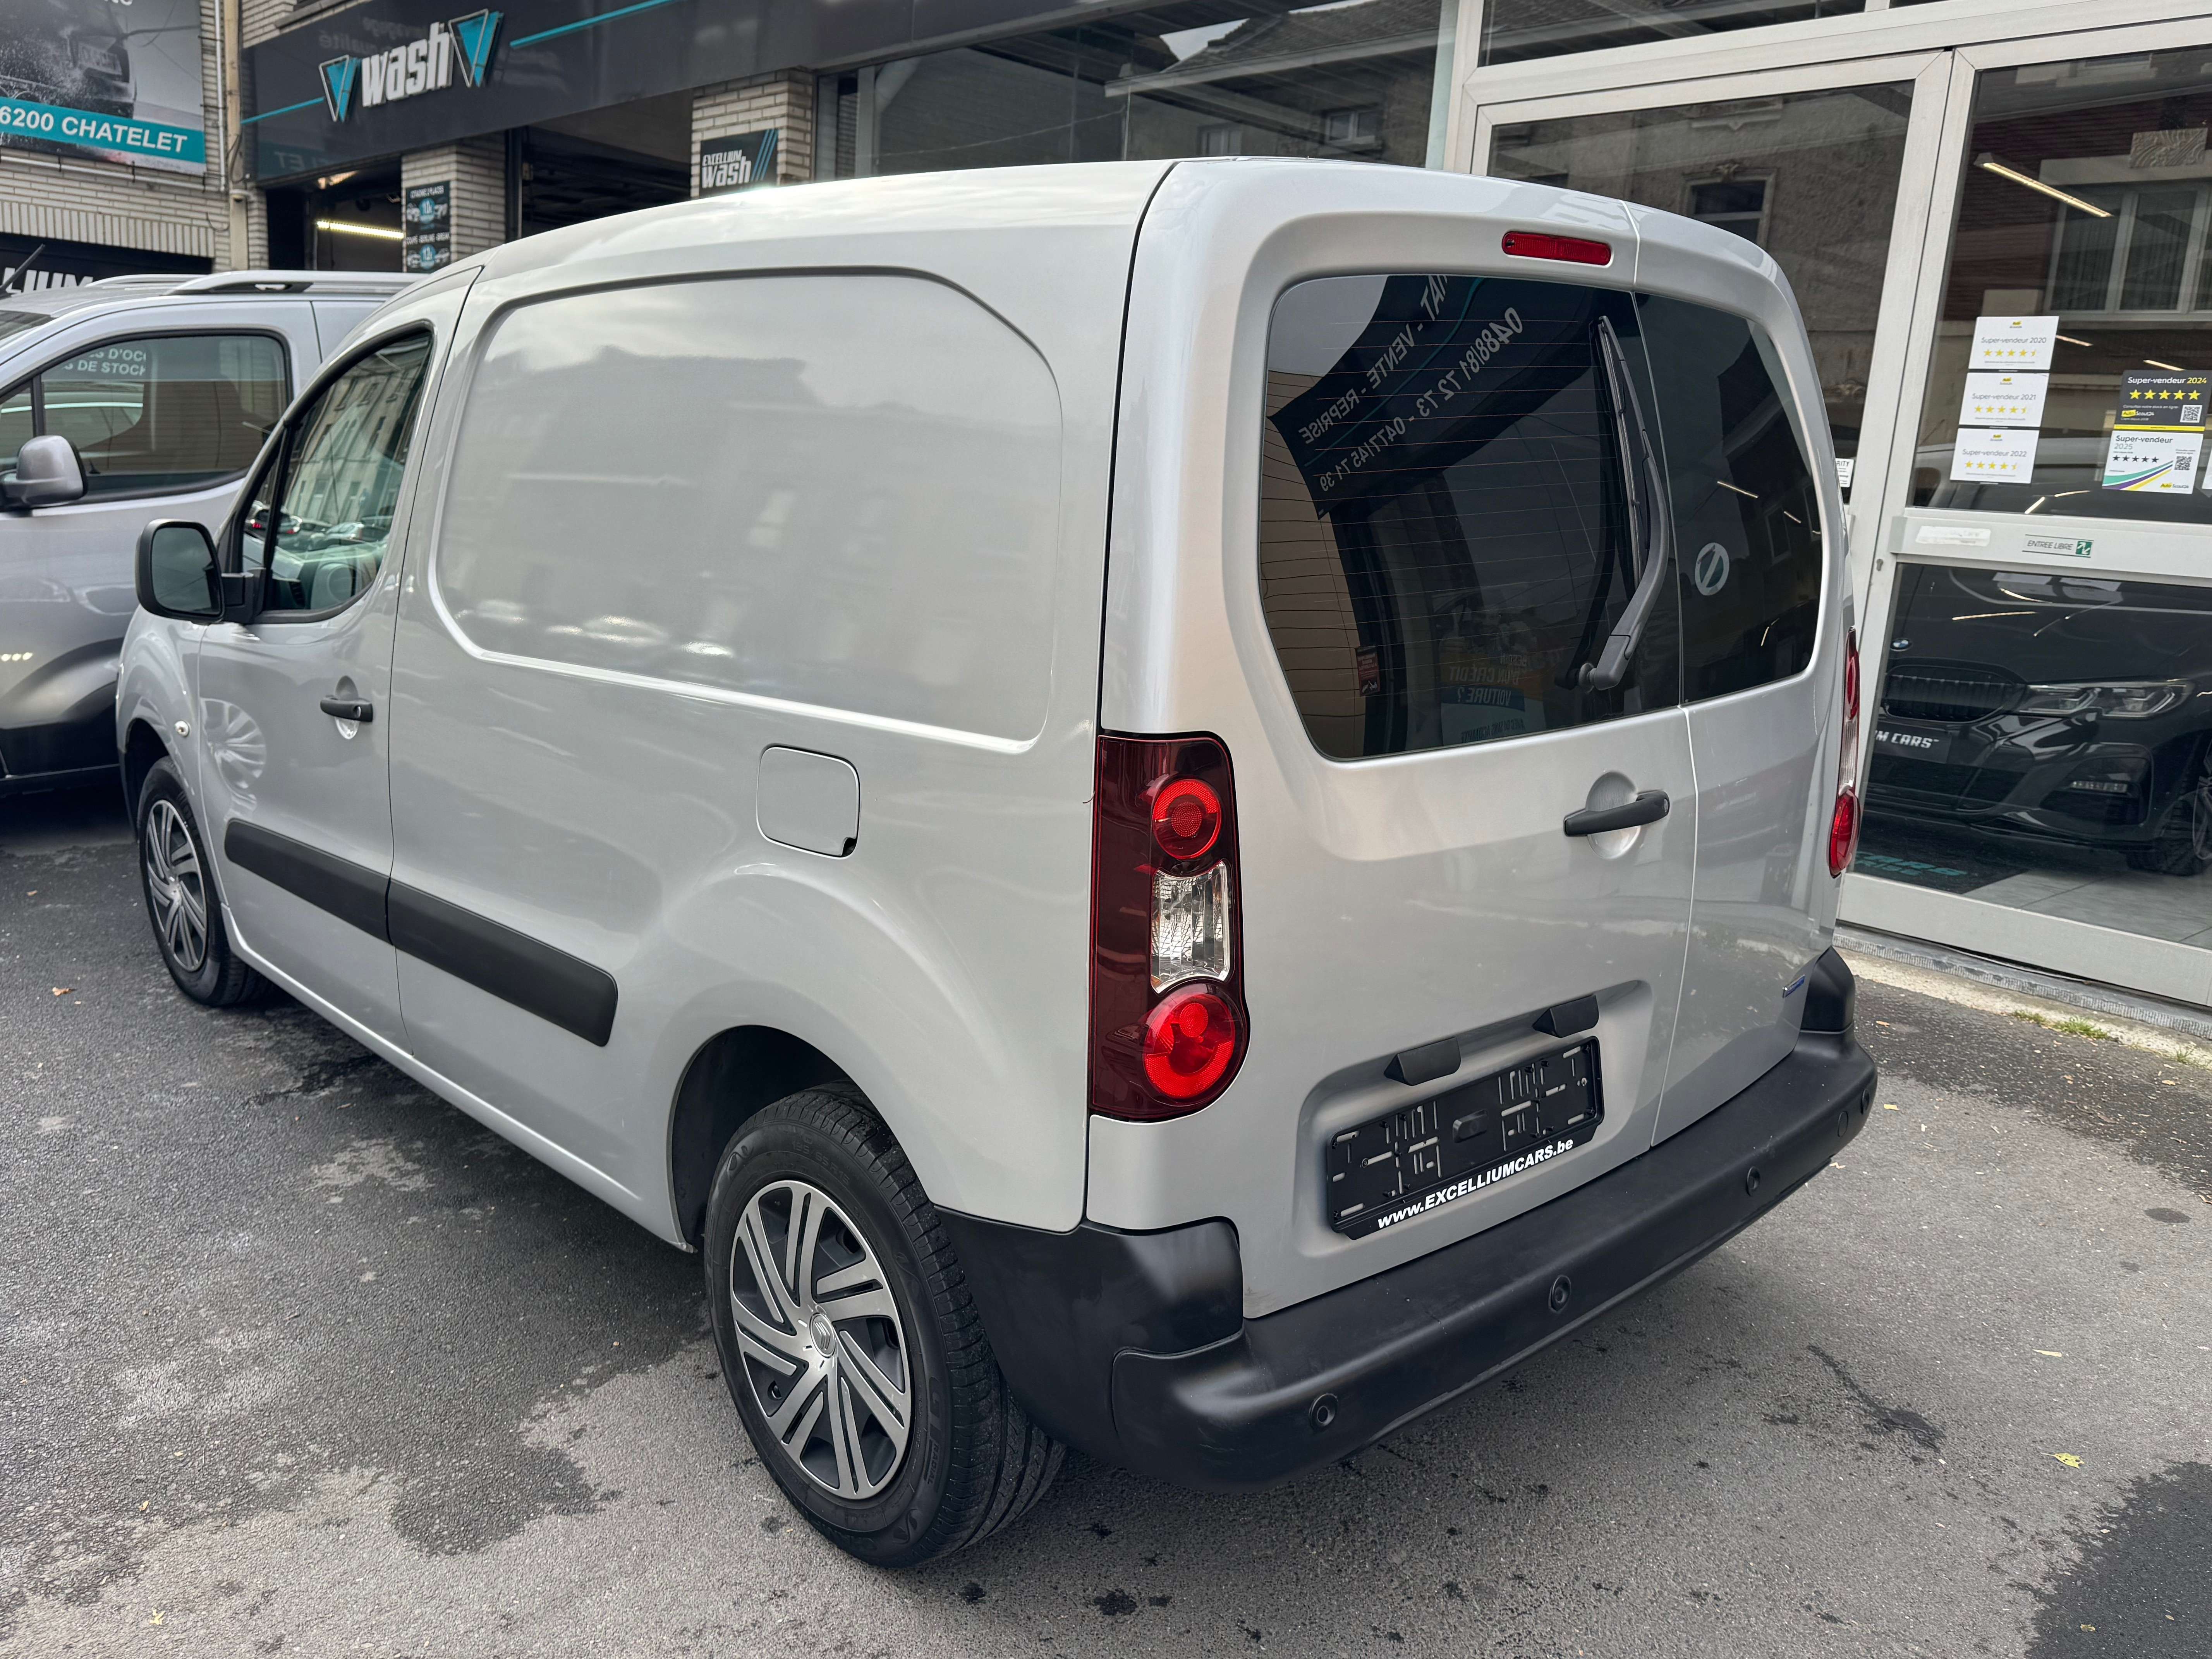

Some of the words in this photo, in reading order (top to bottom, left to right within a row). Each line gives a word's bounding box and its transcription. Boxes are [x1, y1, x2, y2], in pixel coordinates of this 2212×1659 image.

[362, 22, 452, 107] wash
[0, 106, 54, 131] 6200
[62, 117, 188, 153] CHATELET
[702, 149, 742, 166] EXCELLIUM
[702, 156, 752, 188] wash
[78, 360, 98, 372] DE
[2128, 376, 2186, 385] Super-vendeur
[2116, 435, 2173, 443] Super-vendeur
[2027, 540, 2053, 548] ENTREE
[1891, 733, 1933, 749] CARS
[1377, 1139, 1574, 1229] www.EXCELLIUMCARS.be
[927, 1443, 940, 1485] RADIAL
